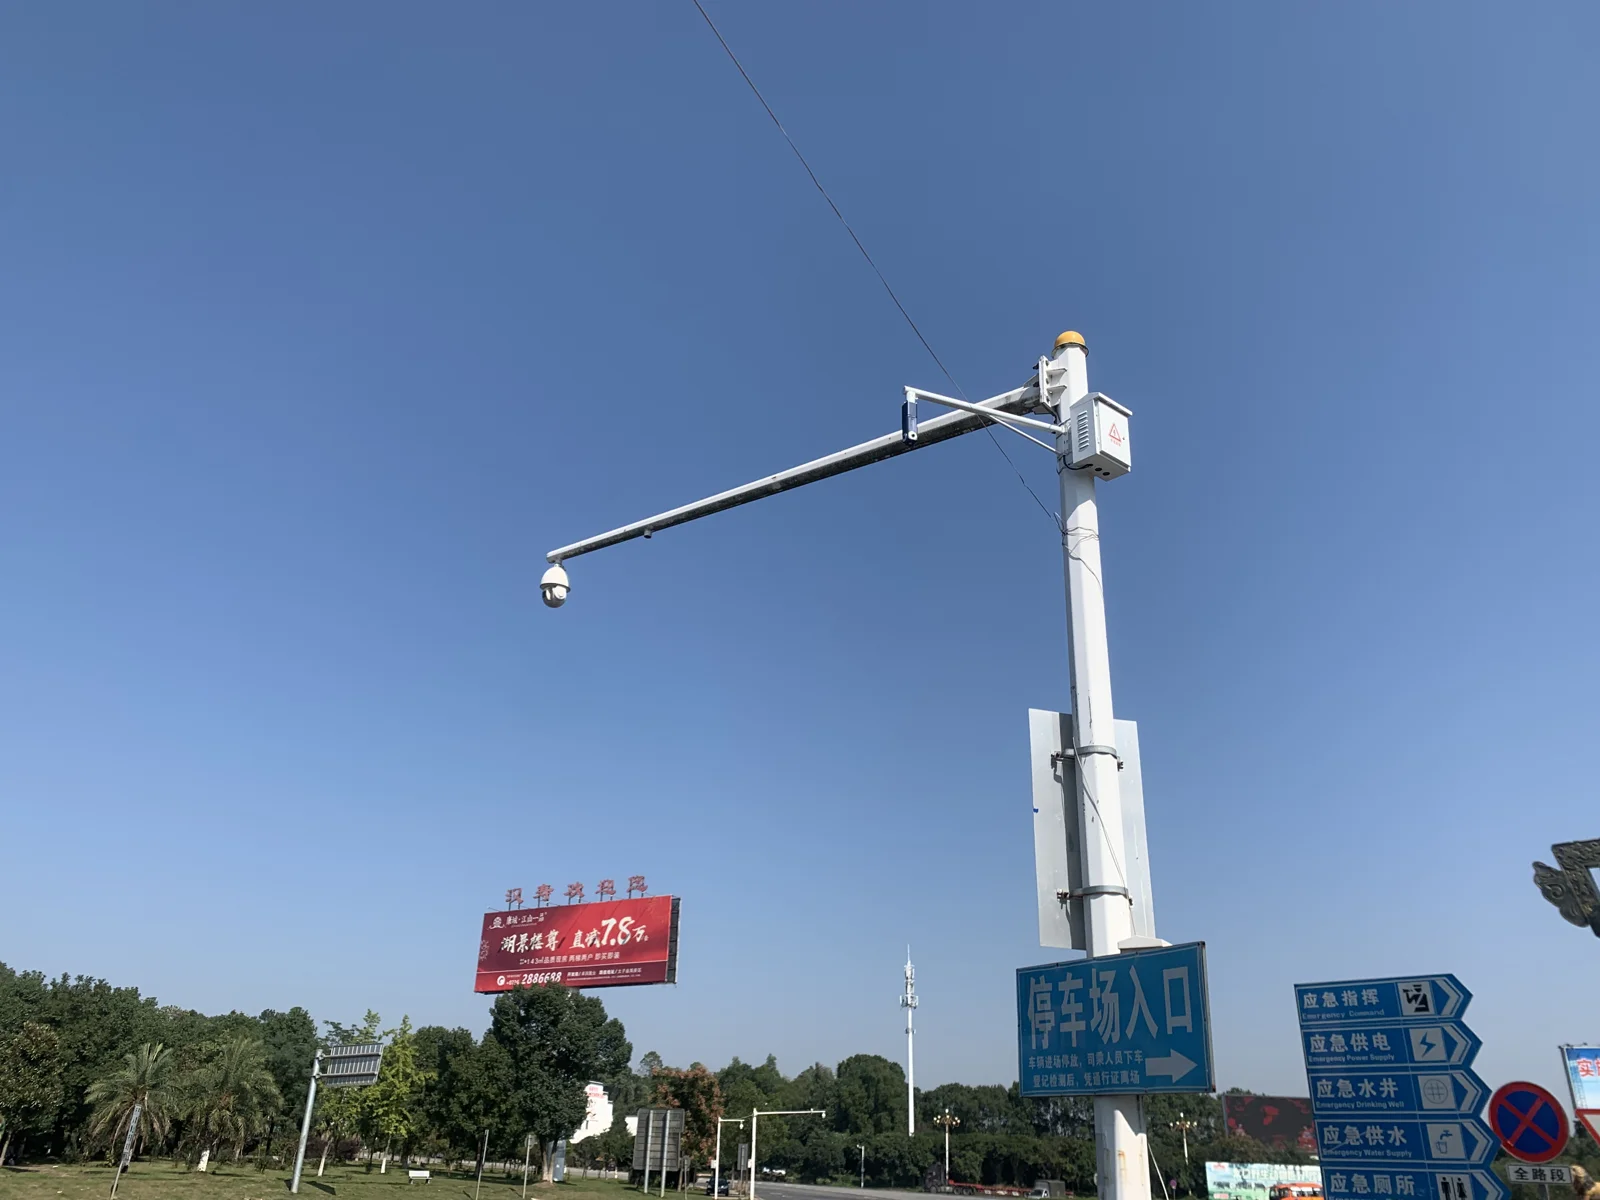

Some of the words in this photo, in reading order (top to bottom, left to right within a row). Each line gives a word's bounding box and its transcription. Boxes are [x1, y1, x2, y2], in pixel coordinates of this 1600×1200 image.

[1027, 964, 1193, 1050] 停车场入口
[1303, 988, 1380, 1009] 应急指挥
[1302, 1011, 1346, 1020] Emergency
[1349, 1009, 1385, 1017] Command
[1310, 1032, 1391, 1053] 应急供电
[1308, 1055, 1346, 1063] Emergency
[1370, 1054, 1394, 1062] Supply
[1316, 1078, 1399, 1098] 应急水井
[1316, 1101, 1355, 1109] Emergency
[1356, 1101, 1388, 1109] Drinking
[1323, 1124, 1408, 1146] 应急供水
[1323, 1149, 1363, 1157] Emergency
[1386, 1150, 1412, 1158] Supply
[1330, 1172, 1415, 1196] 应急厕所
[1513, 1167, 1566, 1182] 全路段
